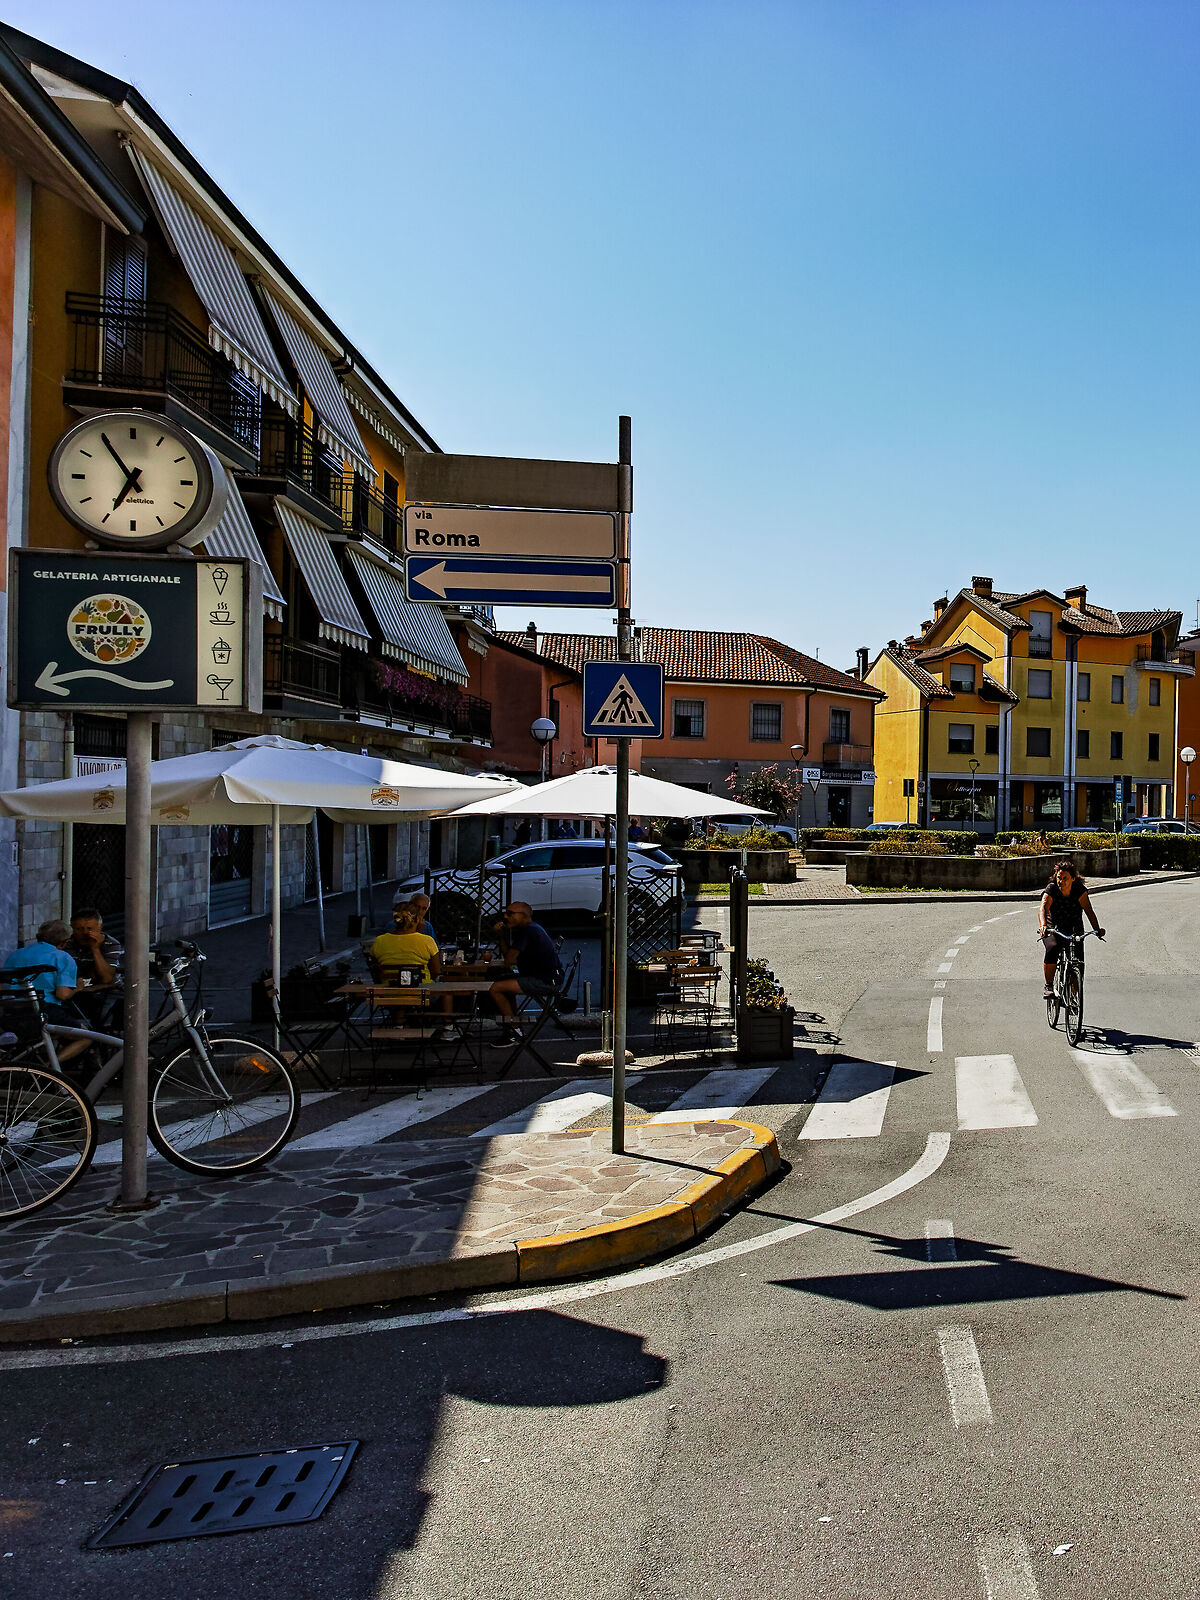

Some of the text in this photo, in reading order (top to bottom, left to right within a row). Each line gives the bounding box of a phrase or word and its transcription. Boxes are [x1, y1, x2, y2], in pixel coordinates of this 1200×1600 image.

[126, 497, 154, 505] elettrica
[415, 511, 433, 520] via
[415, 528, 480, 547] Roma
[33, 570, 181, 584] GELATERIA ARTIGIANALE
[75, 624, 144, 636] FRULLY
